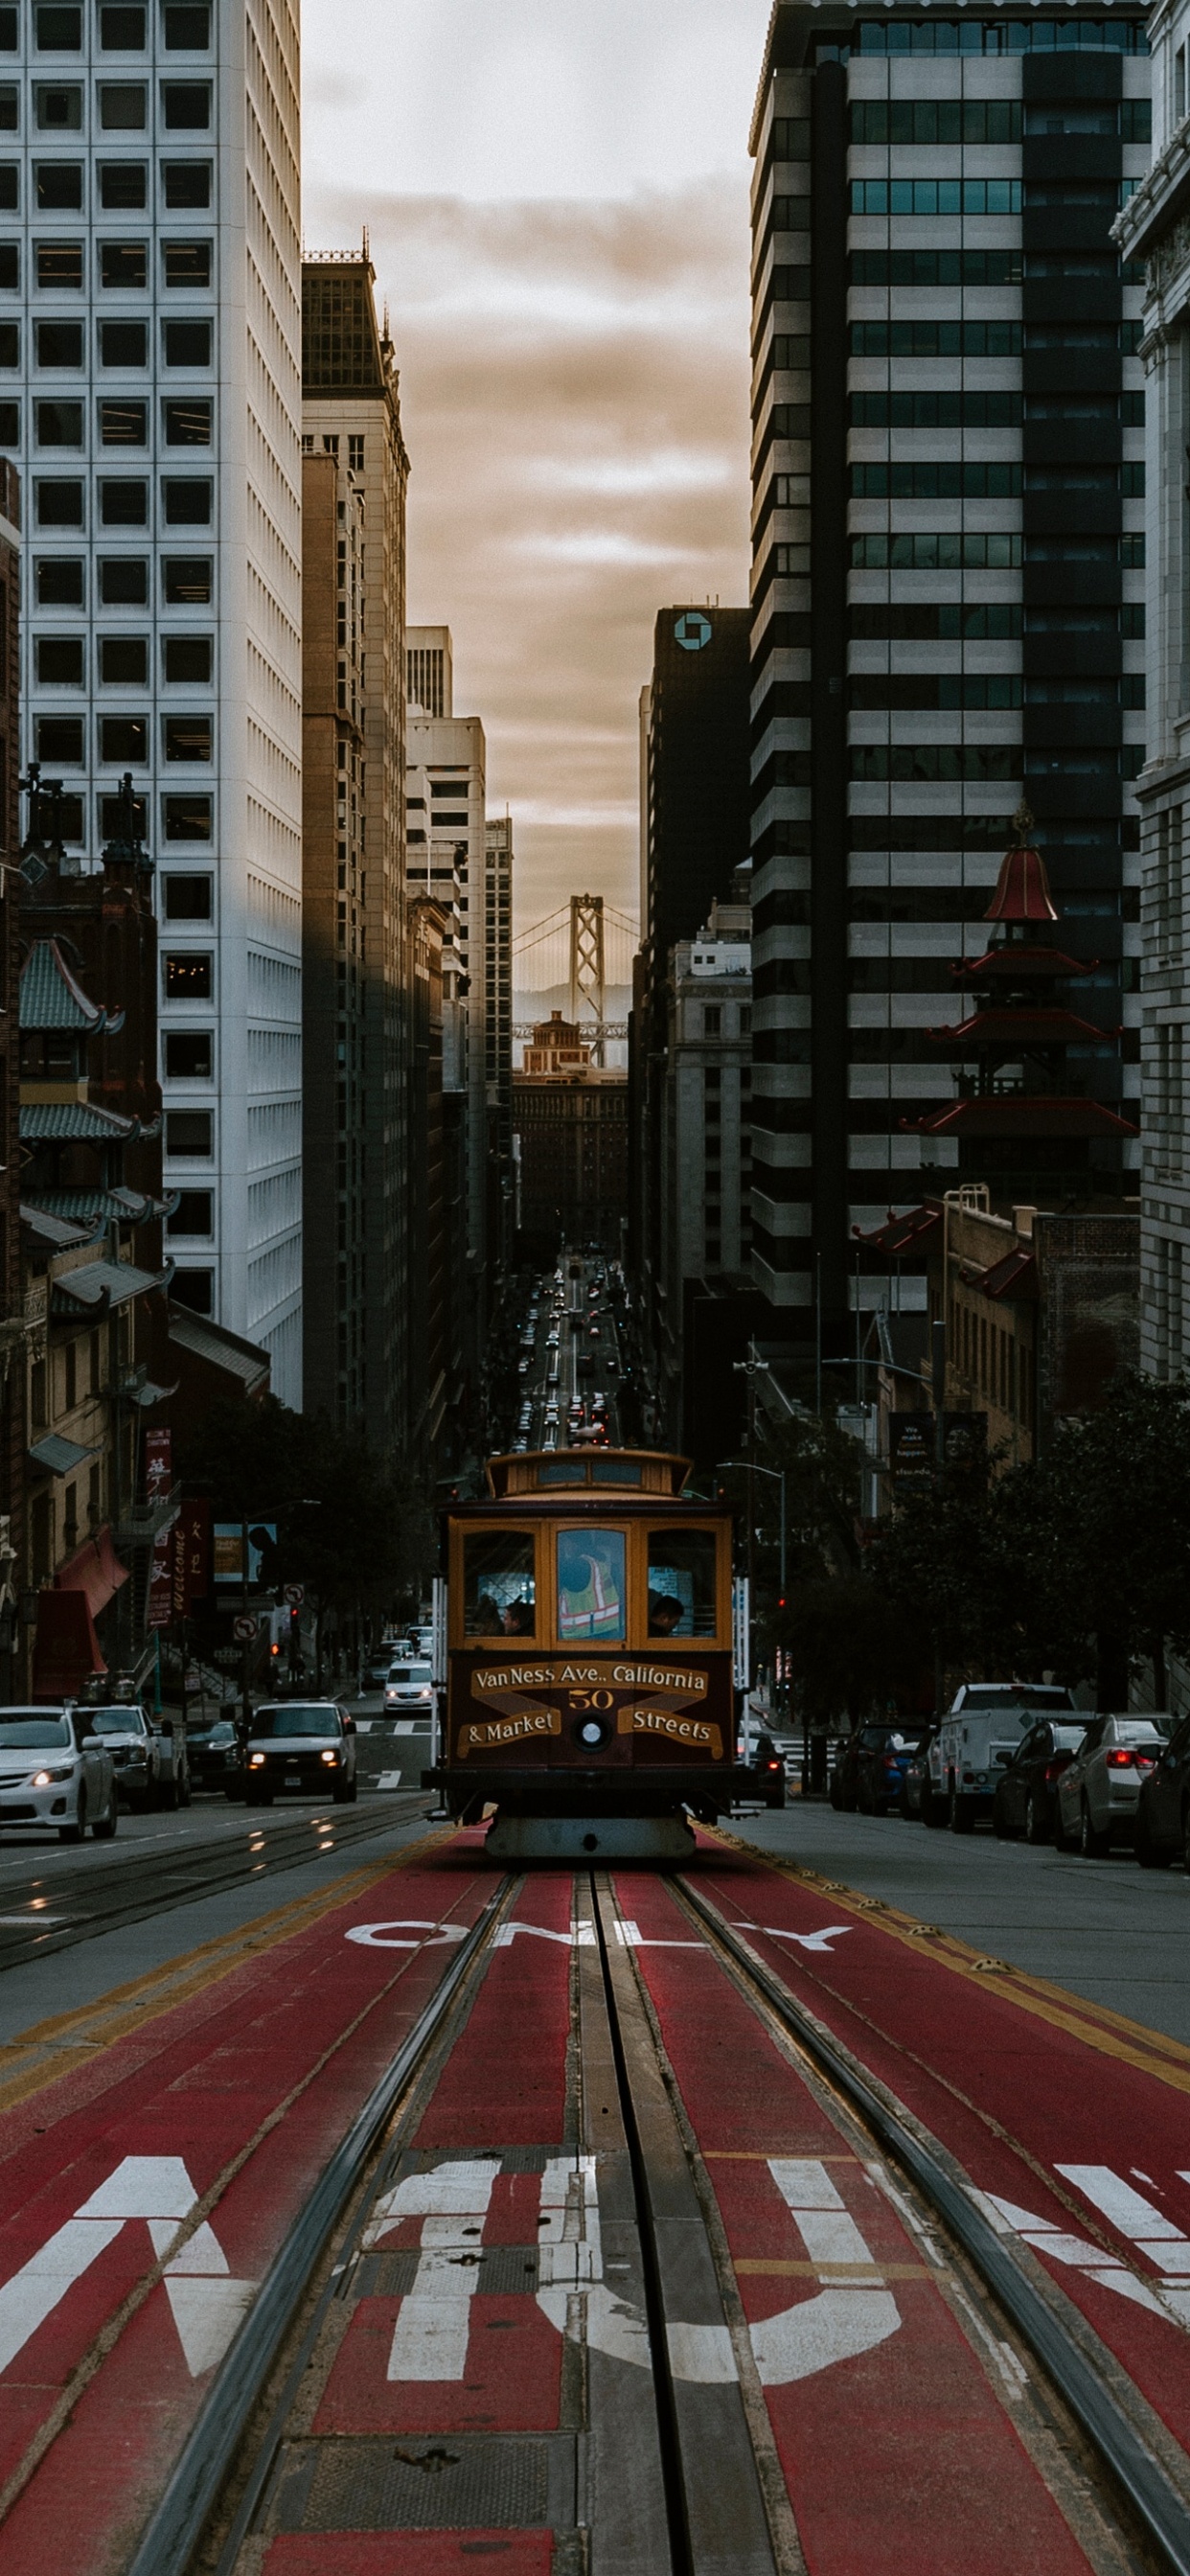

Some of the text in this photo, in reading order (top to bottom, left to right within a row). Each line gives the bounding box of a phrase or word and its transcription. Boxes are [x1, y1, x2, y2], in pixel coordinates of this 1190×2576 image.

[476, 1671, 508, 1688] Van
[511, 1668, 555, 1685] Ness
[613, 1666, 704, 1690] California
[569, 1690, 613, 1710] 50
[469, 1711, 711, 1742] & Market Streets
[344, 1920, 855, 1951] ONLY
